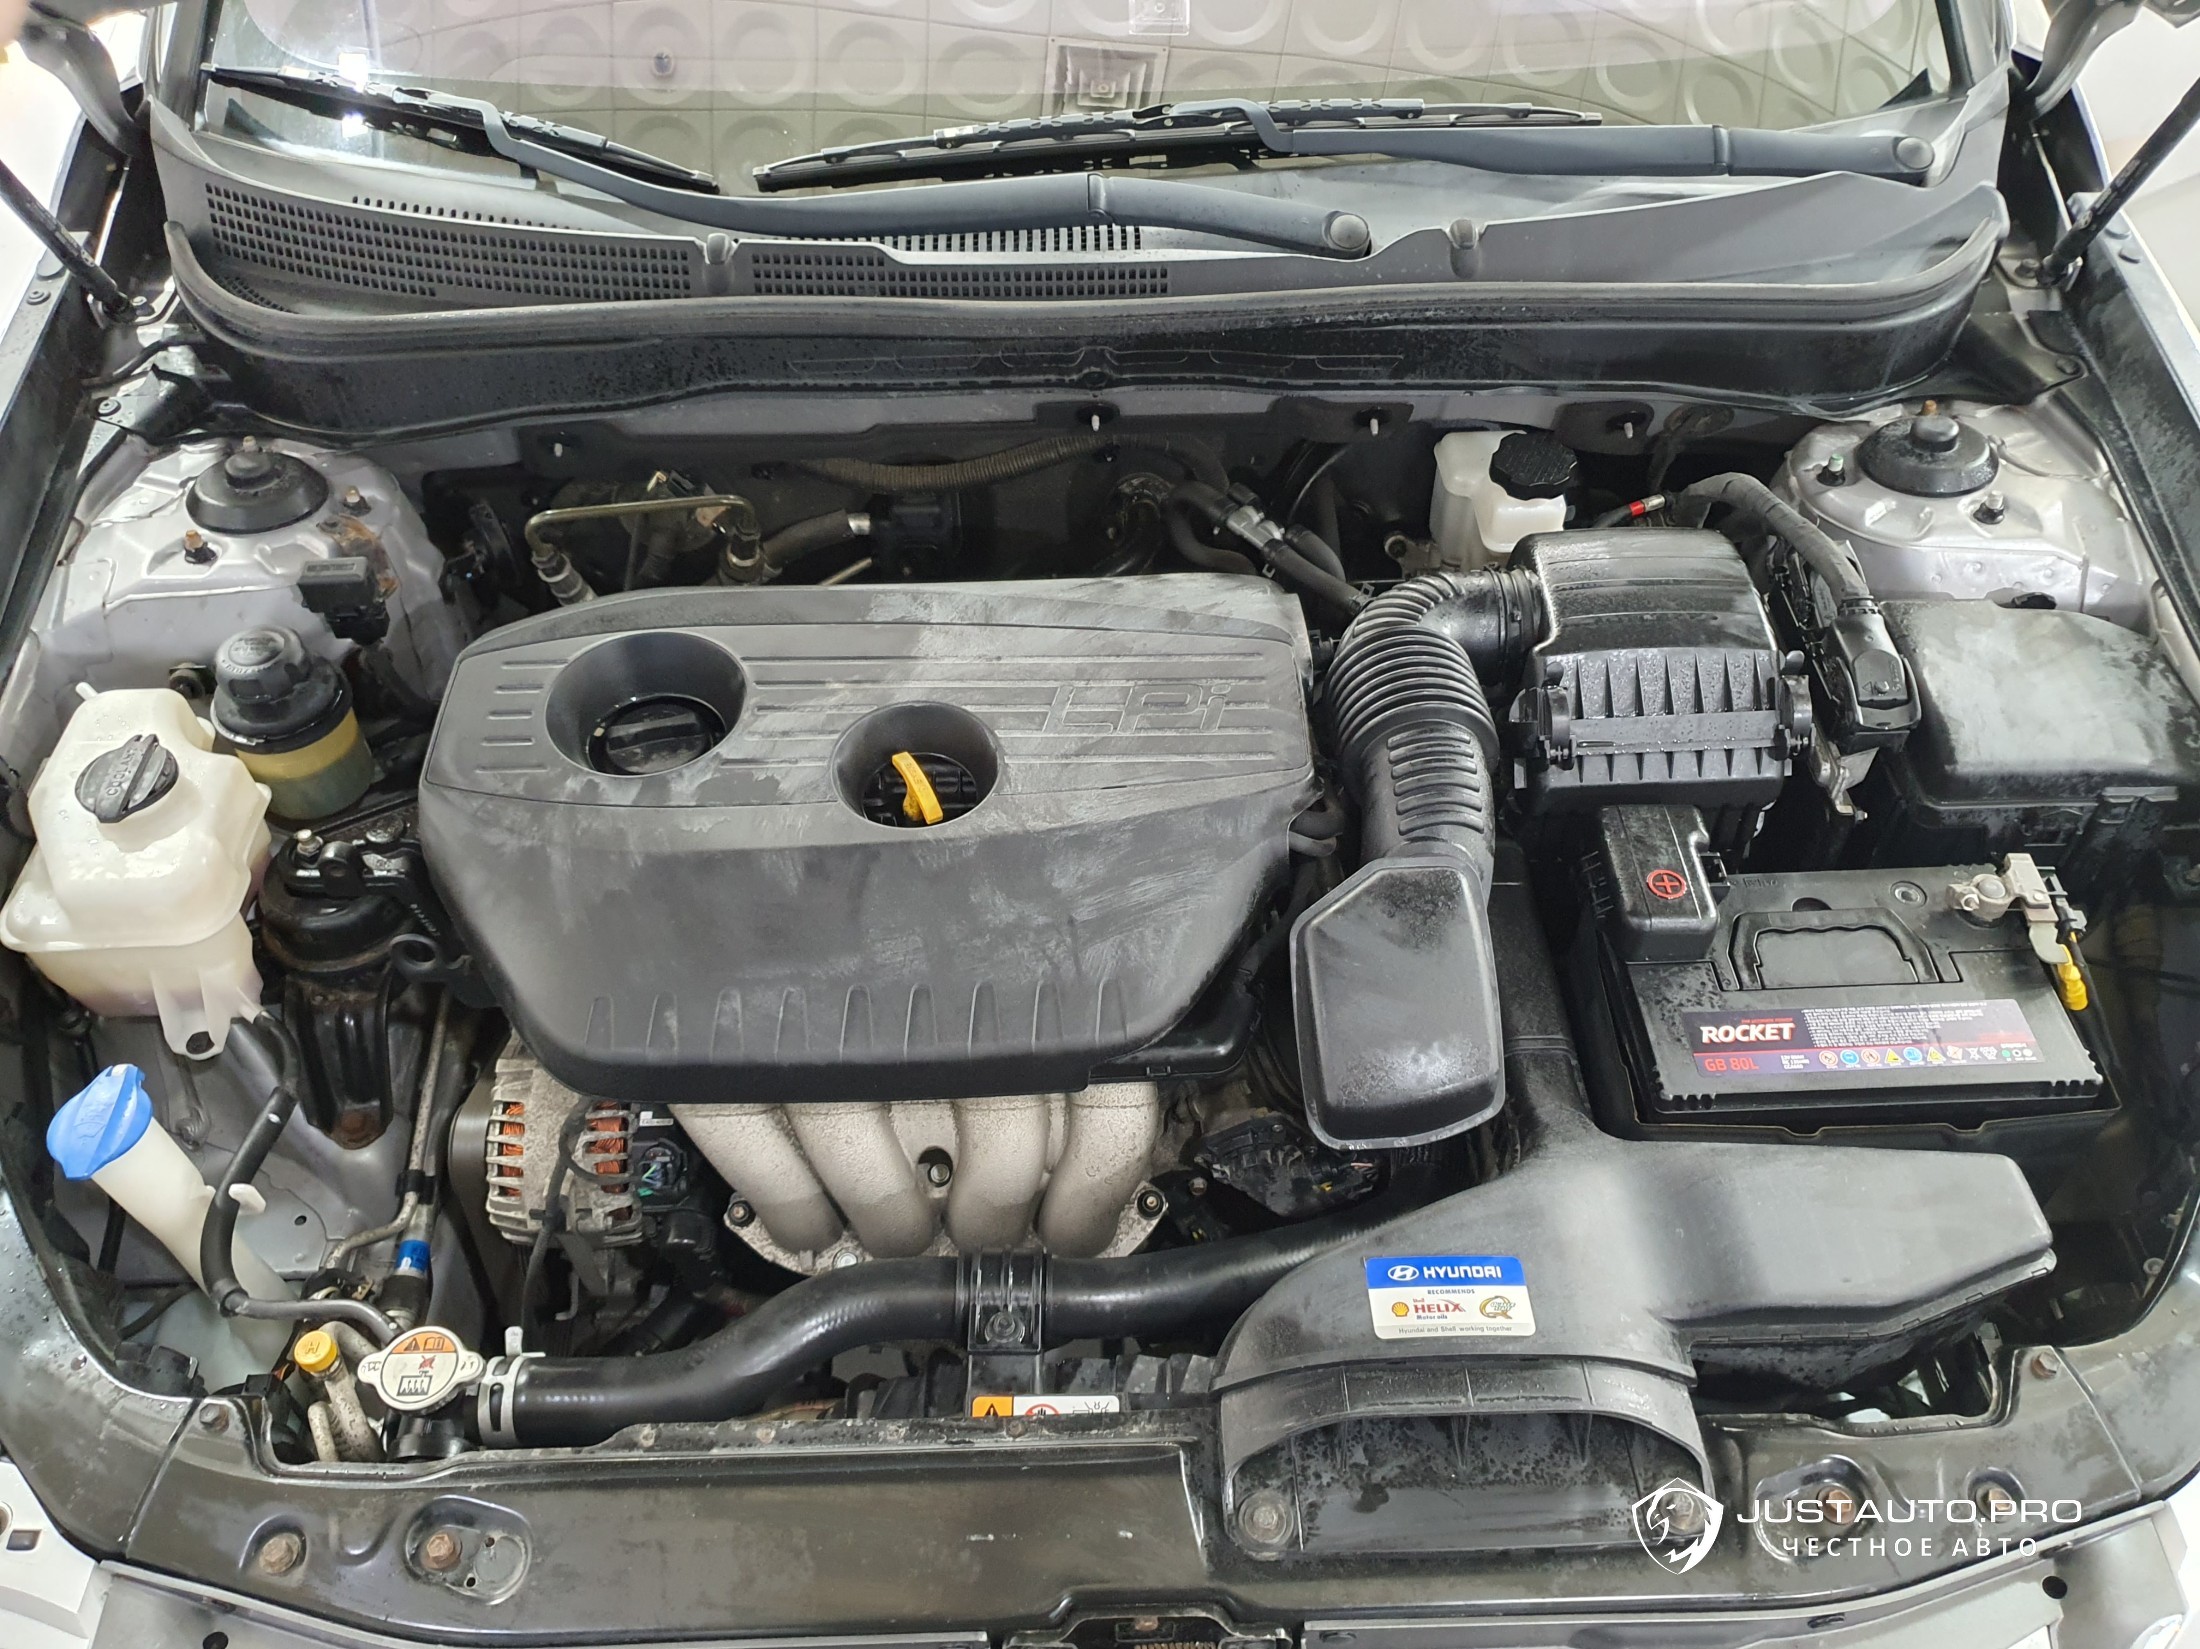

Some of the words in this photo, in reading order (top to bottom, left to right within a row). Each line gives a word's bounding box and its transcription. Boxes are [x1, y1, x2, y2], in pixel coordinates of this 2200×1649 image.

[1700, 1022, 1795, 1043] ROCKET
[1704, 1058, 1727, 1072] GB
[1423, 1265, 1502, 1279] HYUNDAI
[1413, 1303, 1464, 1314] HELIX
[1398, 1326, 1425, 1334] Hyundai
[1459, 1325, 1485, 1333] working
[1486, 1325, 1513, 1333] together
